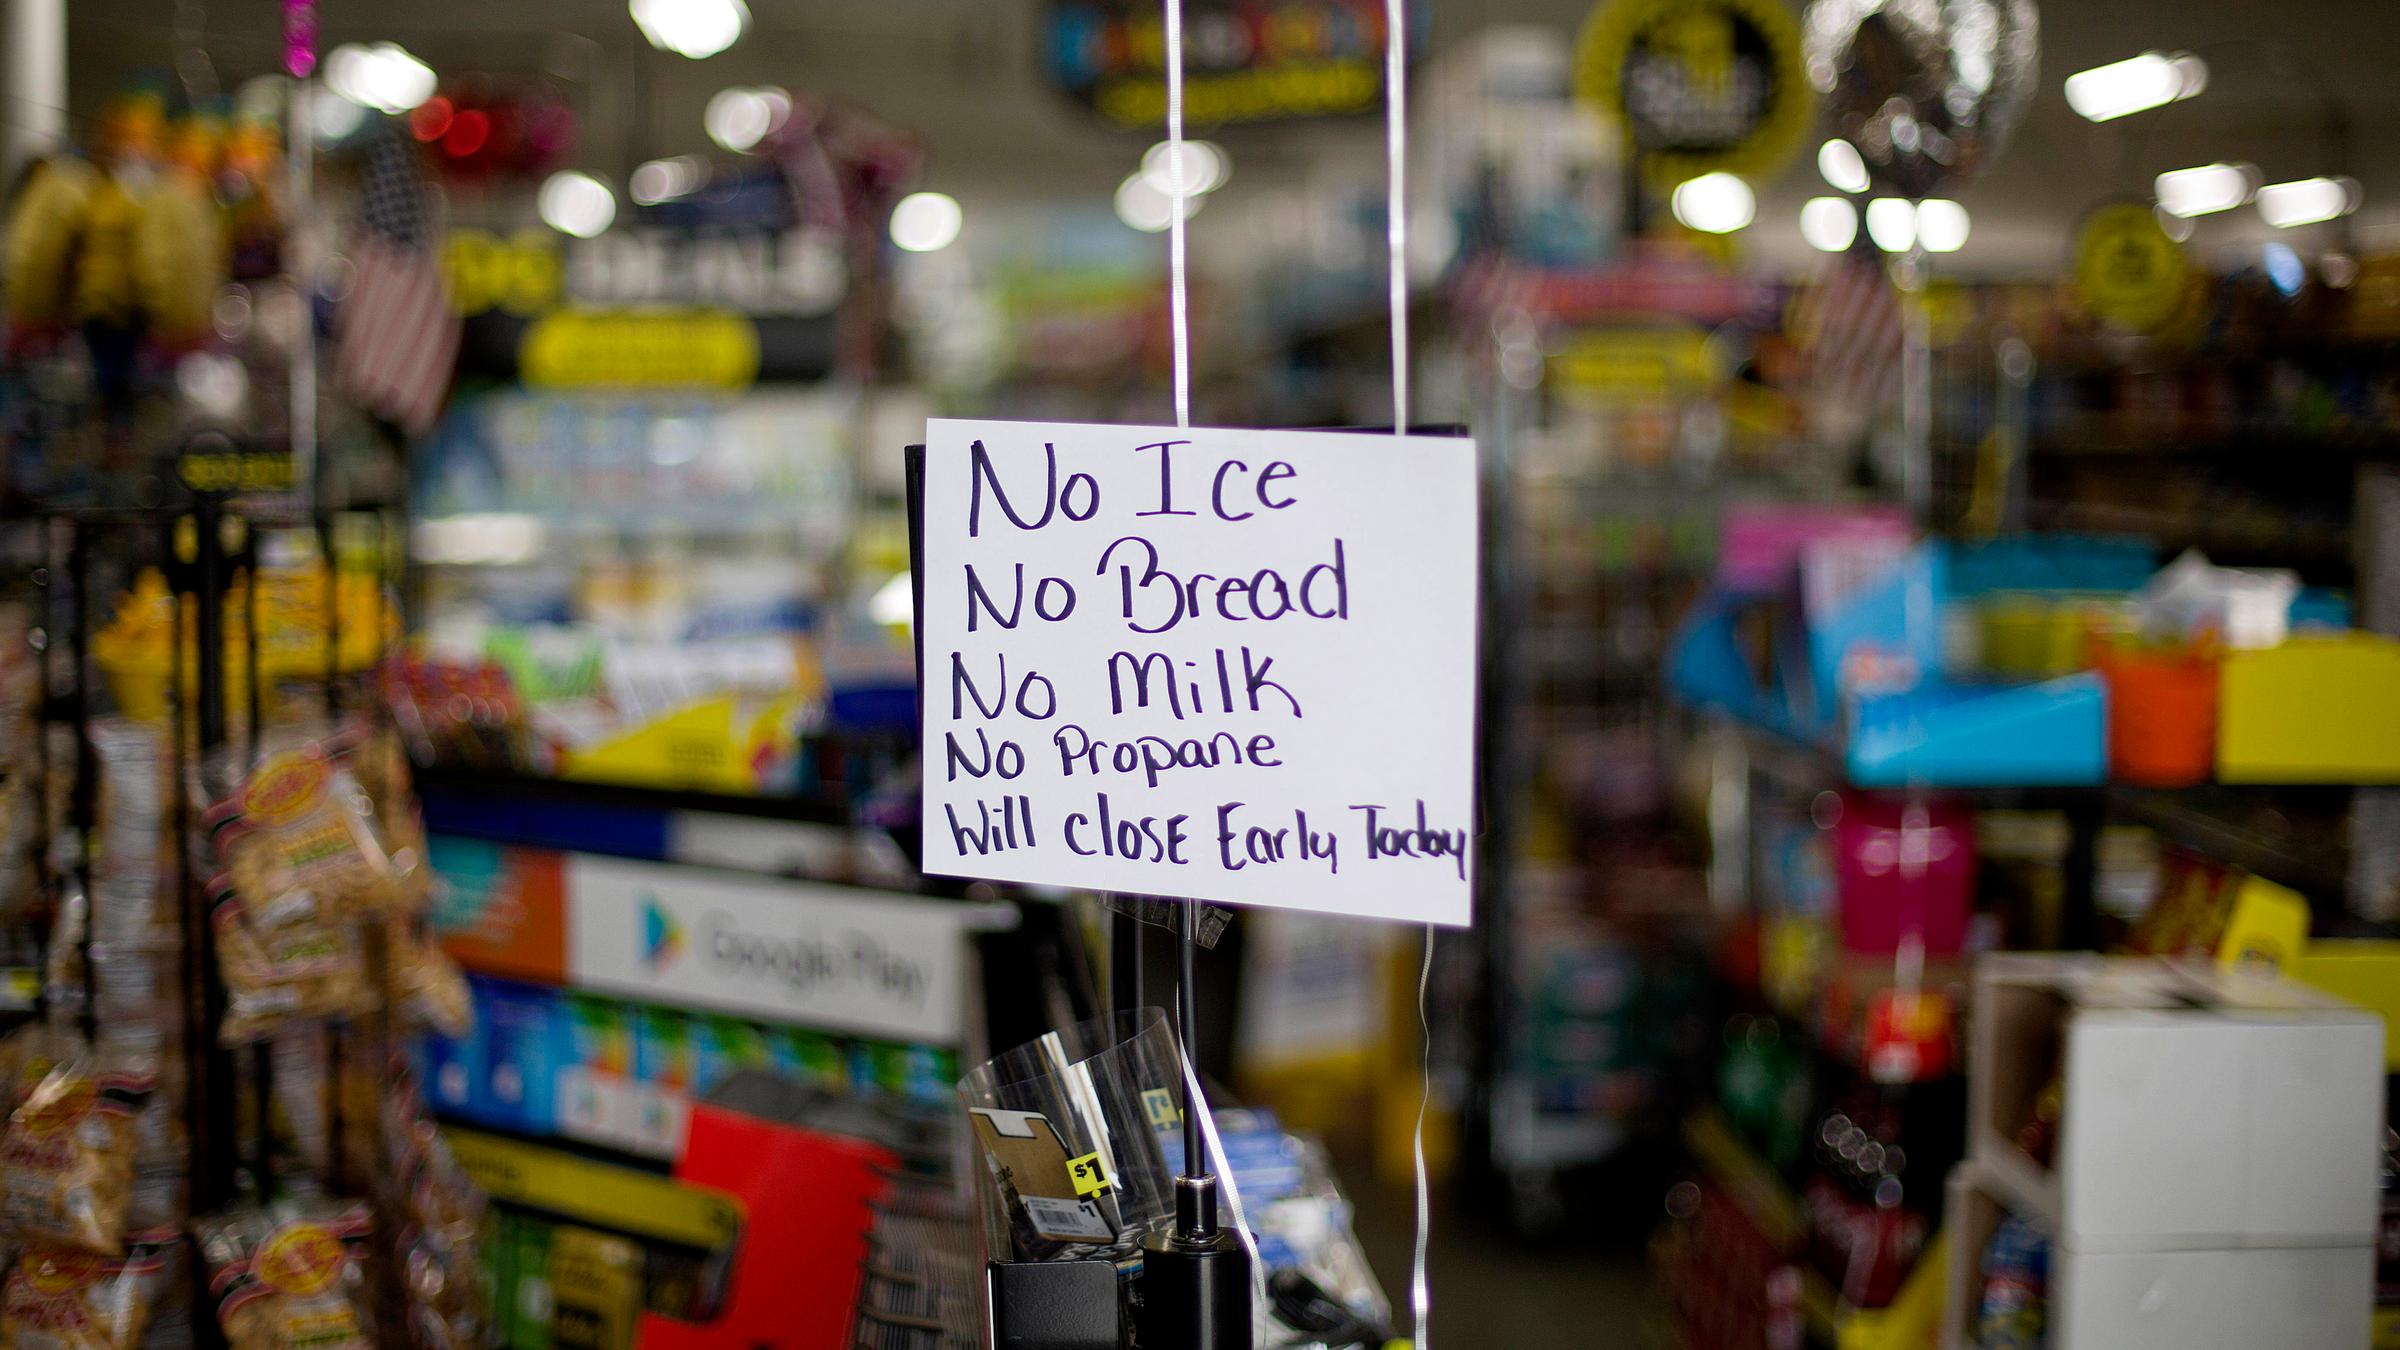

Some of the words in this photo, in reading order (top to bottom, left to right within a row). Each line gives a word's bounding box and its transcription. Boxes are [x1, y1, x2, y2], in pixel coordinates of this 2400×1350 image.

[969, 439, 1100, 538] No
[1134, 440, 1297, 522] Ice
[963, 562, 1077, 633] No
[1096, 536, 1348, 634] Bread
[950, 651, 1057, 721] No
[1108, 645, 1303, 720] Milk
[944, 725, 1025, 783] No
[1053, 724, 1283, 788] Propane
[943, 794, 1036, 856] Will
[1216, 801, 1338, 875] Early
[1348, 800, 1467, 885] Today
[699, 910, 838, 1000] Google
[844, 930, 934, 1014] Play
[1074, 1157, 1105, 1183] $1
